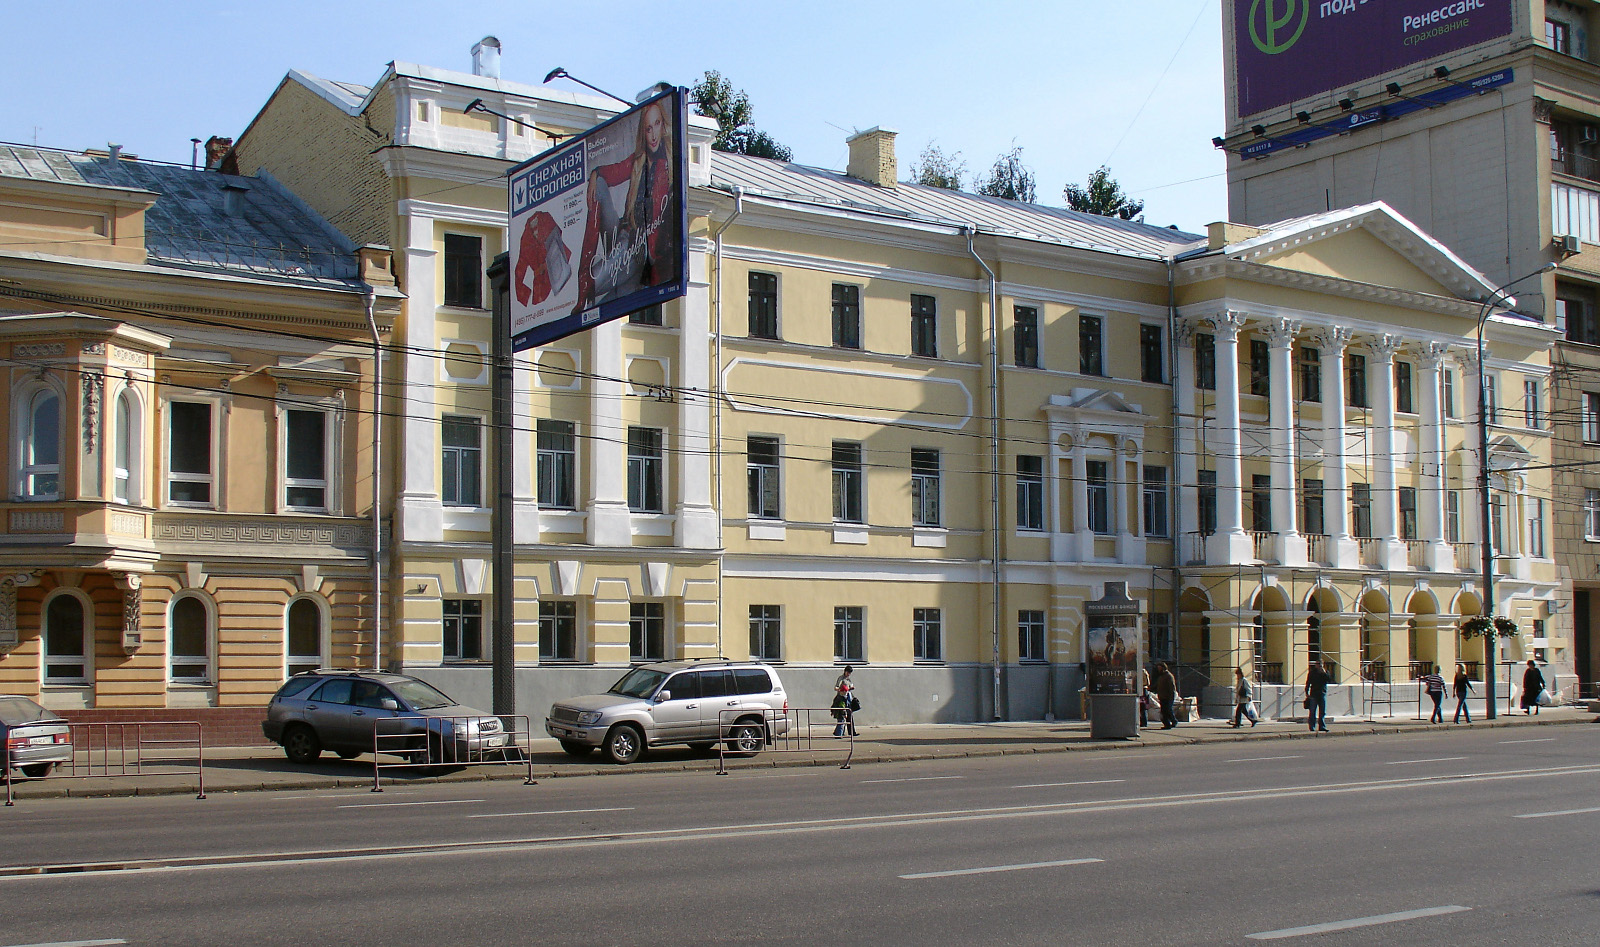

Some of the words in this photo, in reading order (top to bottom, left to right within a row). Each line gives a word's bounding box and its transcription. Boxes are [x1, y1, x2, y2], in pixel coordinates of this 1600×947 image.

[1320, 0, 1356, 19] под
[1403, 0, 1485, 33] Ренессанс
[1403, 18, 1470, 46] страхование
[588, 137, 607, 151] Выбор
[529, 150, 582, 188] Снежная
[529, 167, 582, 205] Королева
